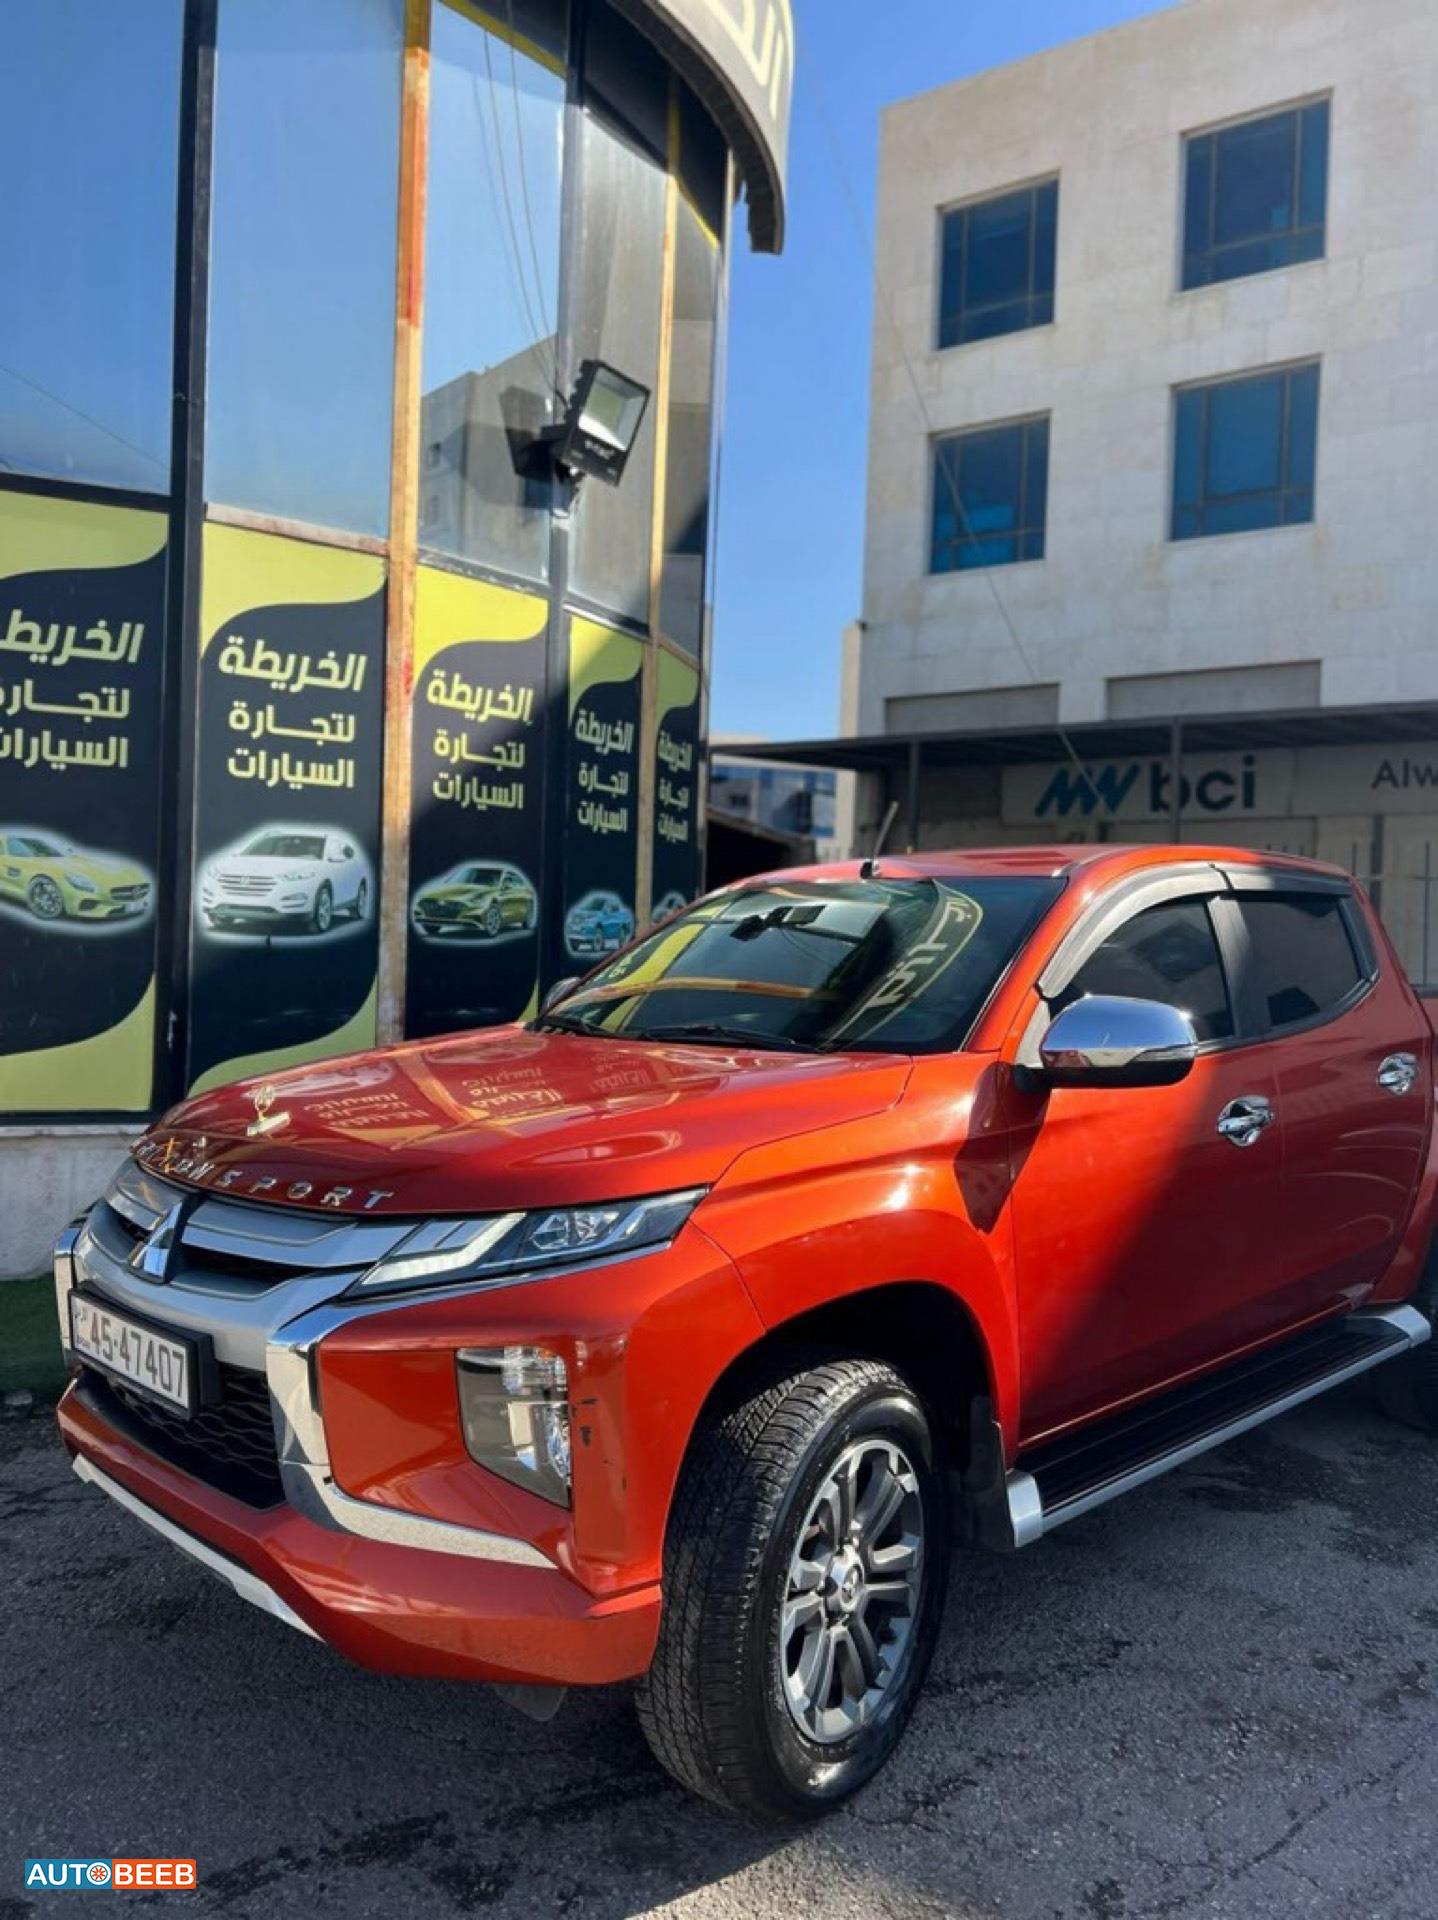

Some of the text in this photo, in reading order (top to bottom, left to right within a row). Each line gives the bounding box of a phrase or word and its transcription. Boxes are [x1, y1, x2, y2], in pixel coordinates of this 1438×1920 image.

[0, 608, 145, 666] الخريط
[218, 635, 368, 693] الخريطة
[0, 678, 130, 723] لتجار
[427, 668, 533, 722] الخريطة
[228, 700, 355, 746] لتجارة
[228, 747, 354, 789] السيارات
[434, 728, 525, 771] لتجارة
[432, 771, 523, 810] السيارات
[1151, 755, 1256, 813] bci
[216, 1170, 395, 1209] SPORT
